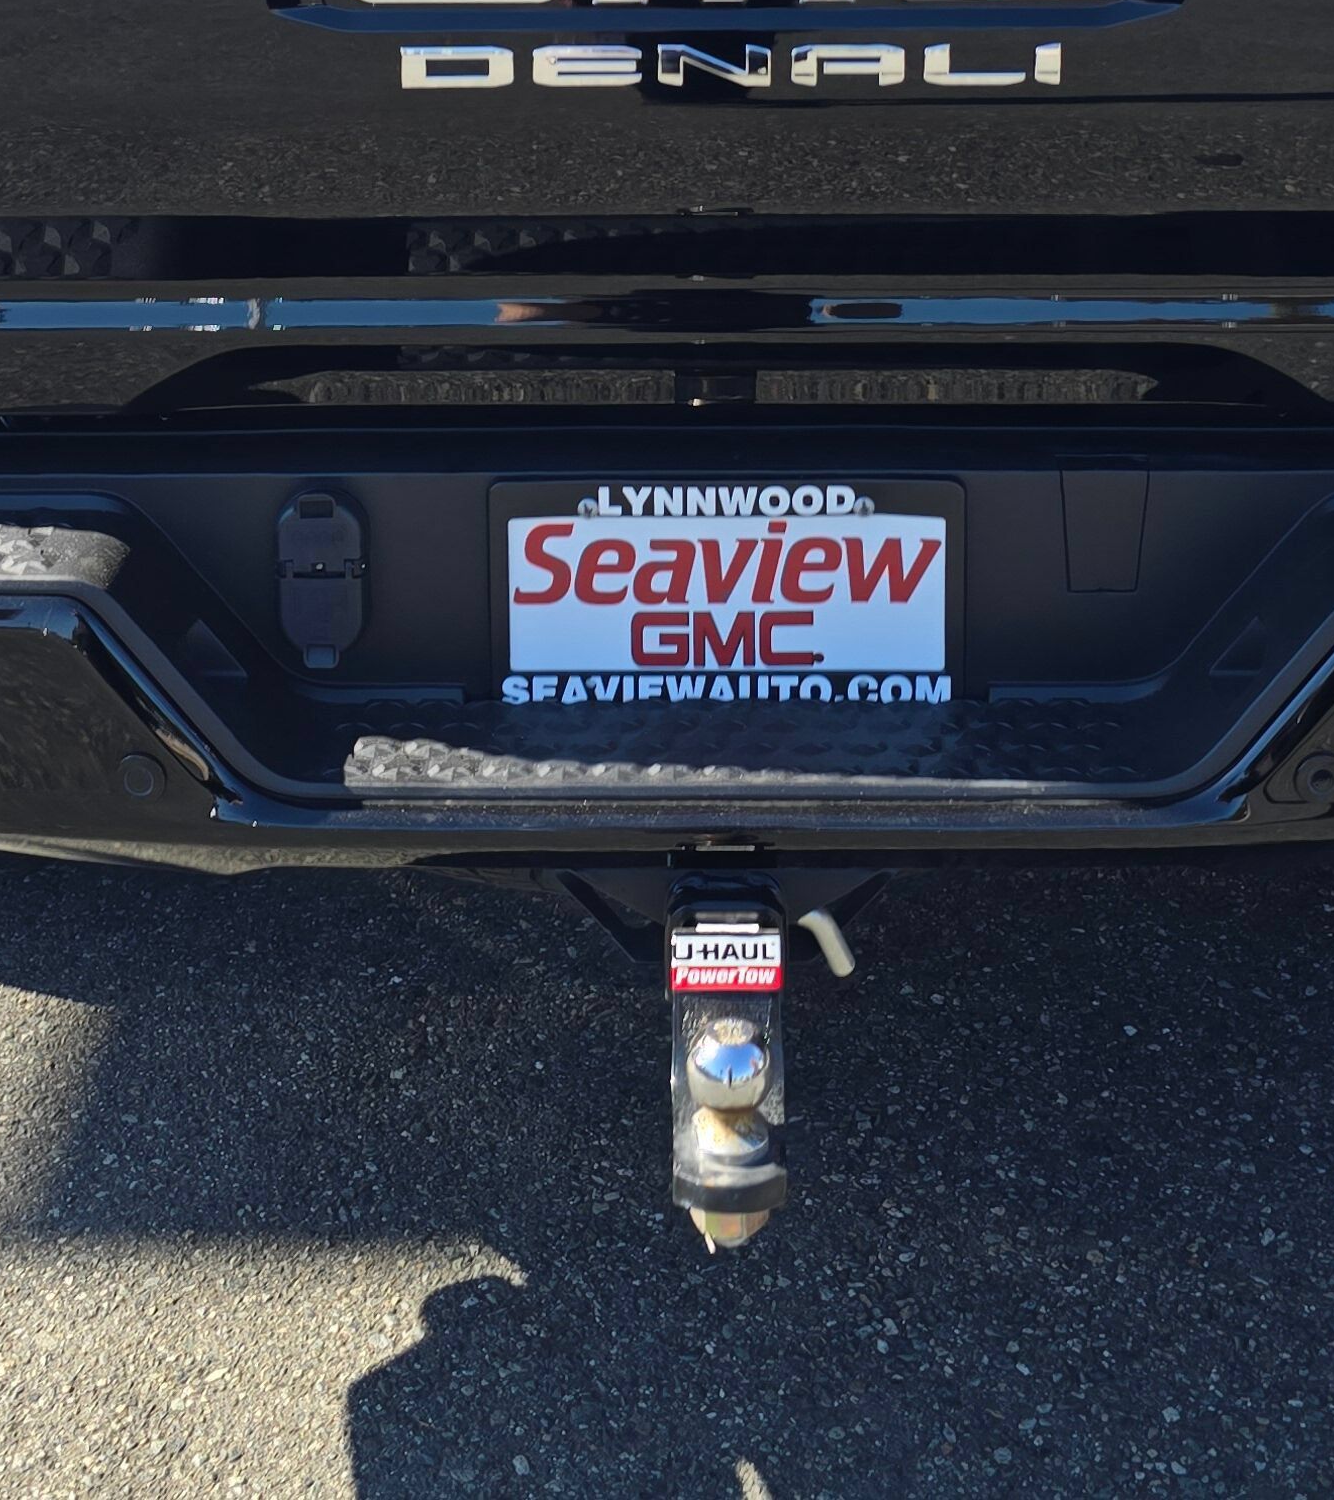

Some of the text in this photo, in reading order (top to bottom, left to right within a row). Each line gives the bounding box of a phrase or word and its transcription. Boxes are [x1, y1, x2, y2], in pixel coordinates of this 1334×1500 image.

[401, 43, 1062, 89] DENALI
[597, 485, 857, 517] LYNNWOOD
[513, 520, 943, 606] Seaview
[629, 610, 816, 668] GMC
[501, 674, 952, 705] SEAVIEWAUTO.COM
[672, 943, 776, 960] U-HAUL
[675, 967, 777, 986] PowerTow
